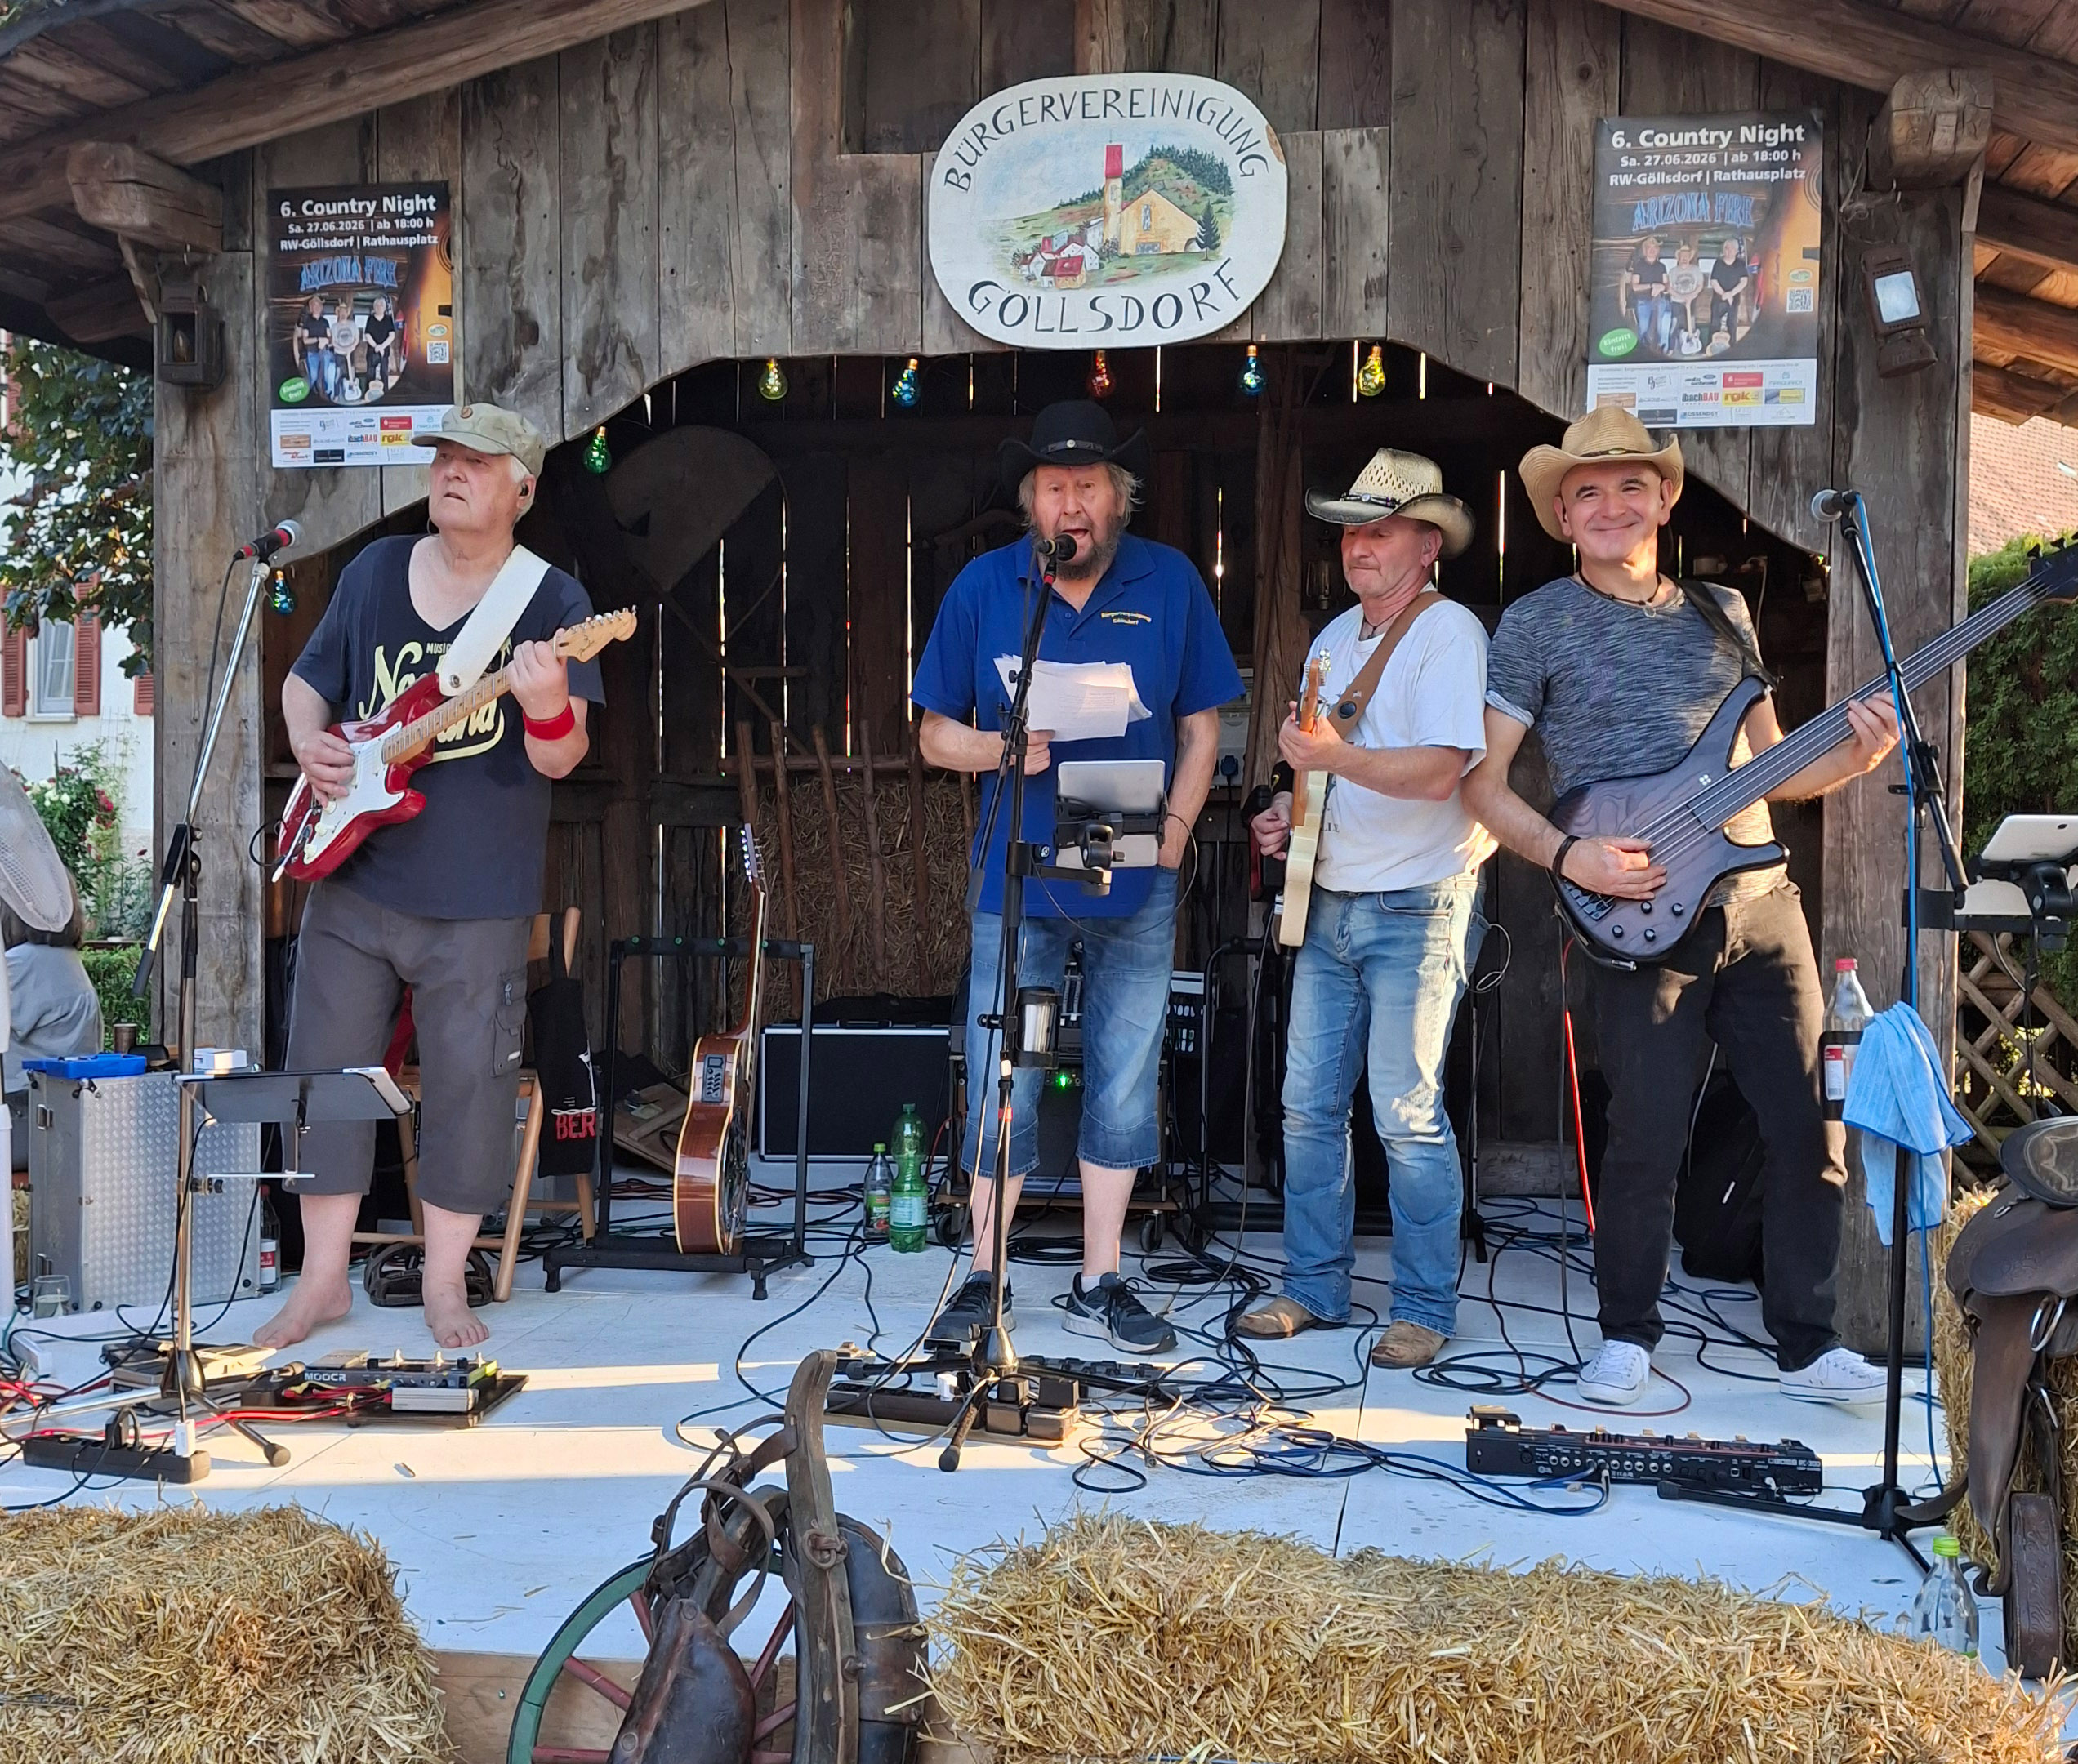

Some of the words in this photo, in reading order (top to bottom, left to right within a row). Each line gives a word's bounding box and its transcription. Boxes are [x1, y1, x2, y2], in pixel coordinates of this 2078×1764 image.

[944, 87, 1270, 194] BÜRGERVEREINIGUNG
[1612, 131, 1632, 149] 6.
[1639, 127, 1733, 149] Country
[1740, 123, 1805, 146] Night
[1621, 155, 1641, 167] Sa.
[1644, 152, 1717, 166] 27.06.2026
[1731, 150, 1749, 163] ab
[1753, 149, 1789, 163] 18:00
[1792, 149, 1801, 161] h
[1609, 170, 1703, 186] RW-Göllsdorf
[1713, 167, 1806, 183] Rathausplatz
[280, 201, 297, 218] 6.
[301, 198, 377, 218] Country
[382, 194, 437, 216] Night
[1632, 192, 1711, 232] ARIZONA
[1715, 192, 1755, 229] FIRE
[288, 223, 305, 234] Sa.
[306, 220, 365, 233] 27.06.2026
[377, 219, 391, 229] ab
[394, 218, 423, 229] 18:00
[426, 216, 435, 228] h
[280, 236, 355, 251] RW-Göllsdorf
[363, 233, 439, 248] Rathausplatz
[300, 255, 363, 292] ARIZONA
[364, 255, 399, 288] FIRE
[968, 257, 1241, 333] GÖLLSDORF
